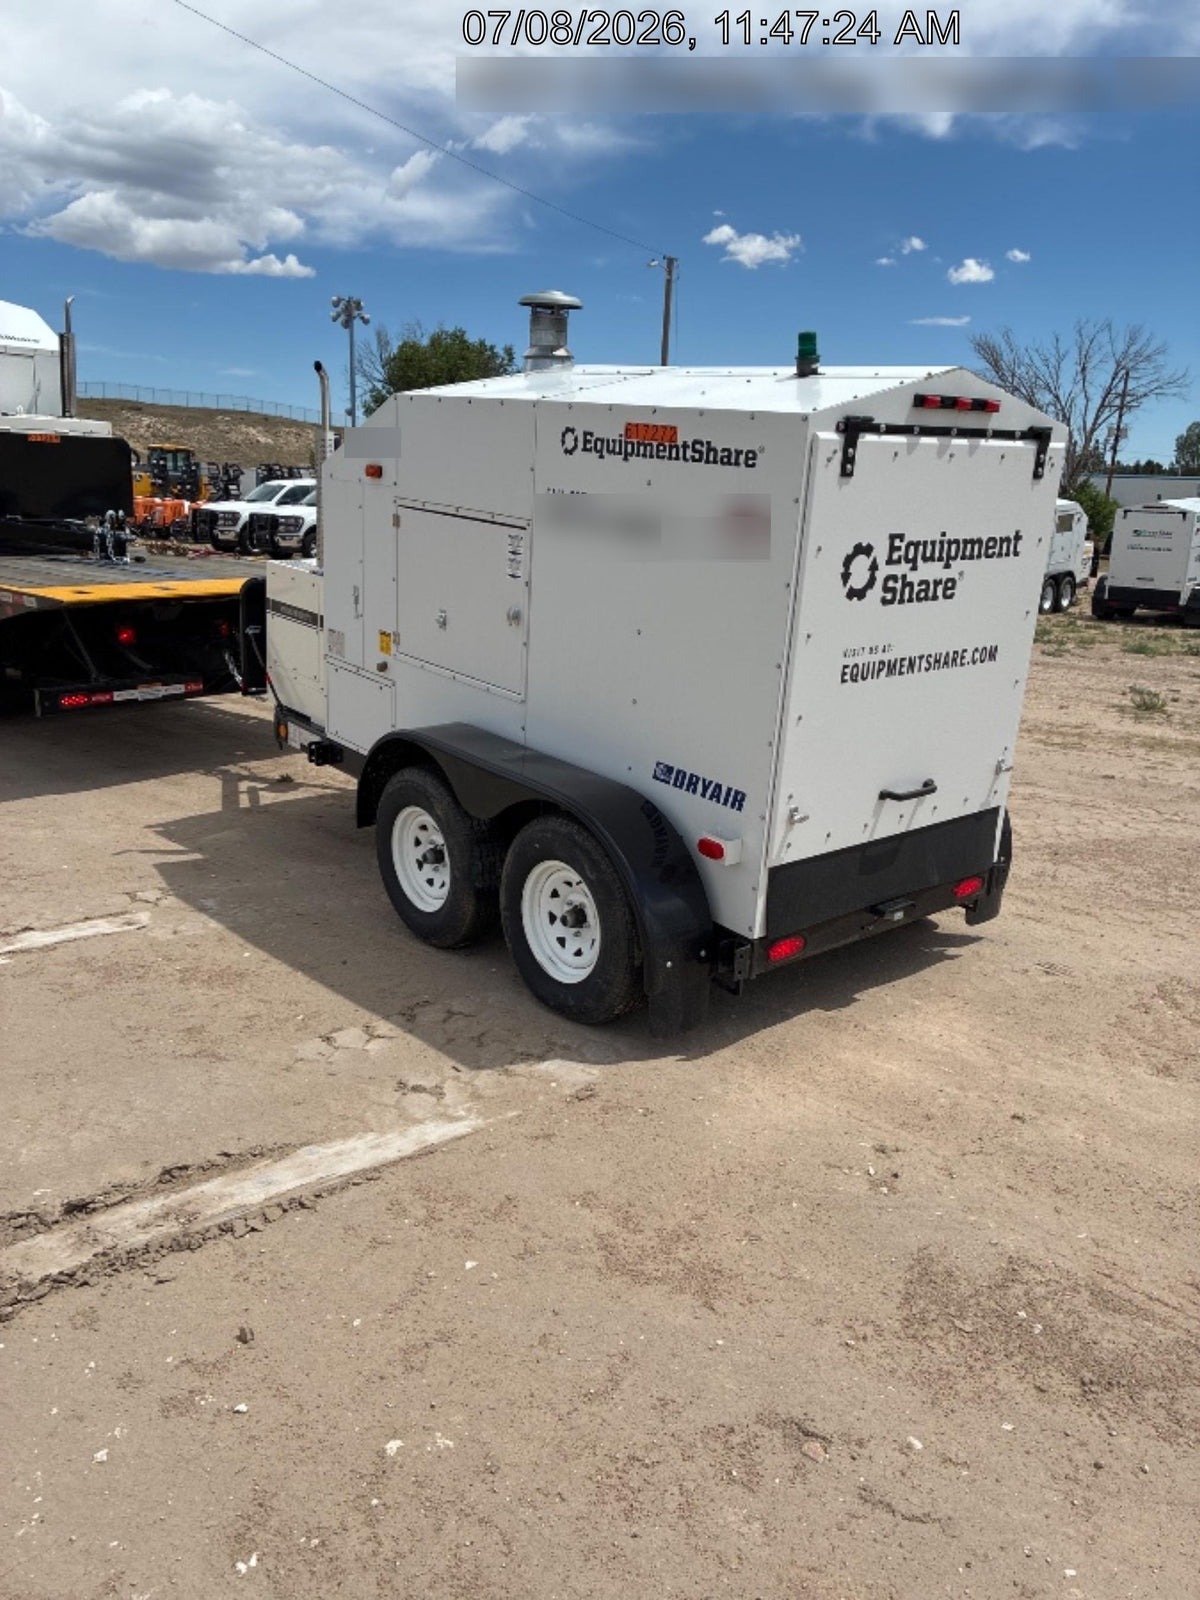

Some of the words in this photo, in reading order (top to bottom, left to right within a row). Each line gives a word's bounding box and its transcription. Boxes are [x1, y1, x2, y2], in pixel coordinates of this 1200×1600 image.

[885, 530, 1023, 571] Equipment
[840, 645, 998, 684] EQUIPMENTSHARE.COM
[672, 768, 747, 812] DRYAIR
